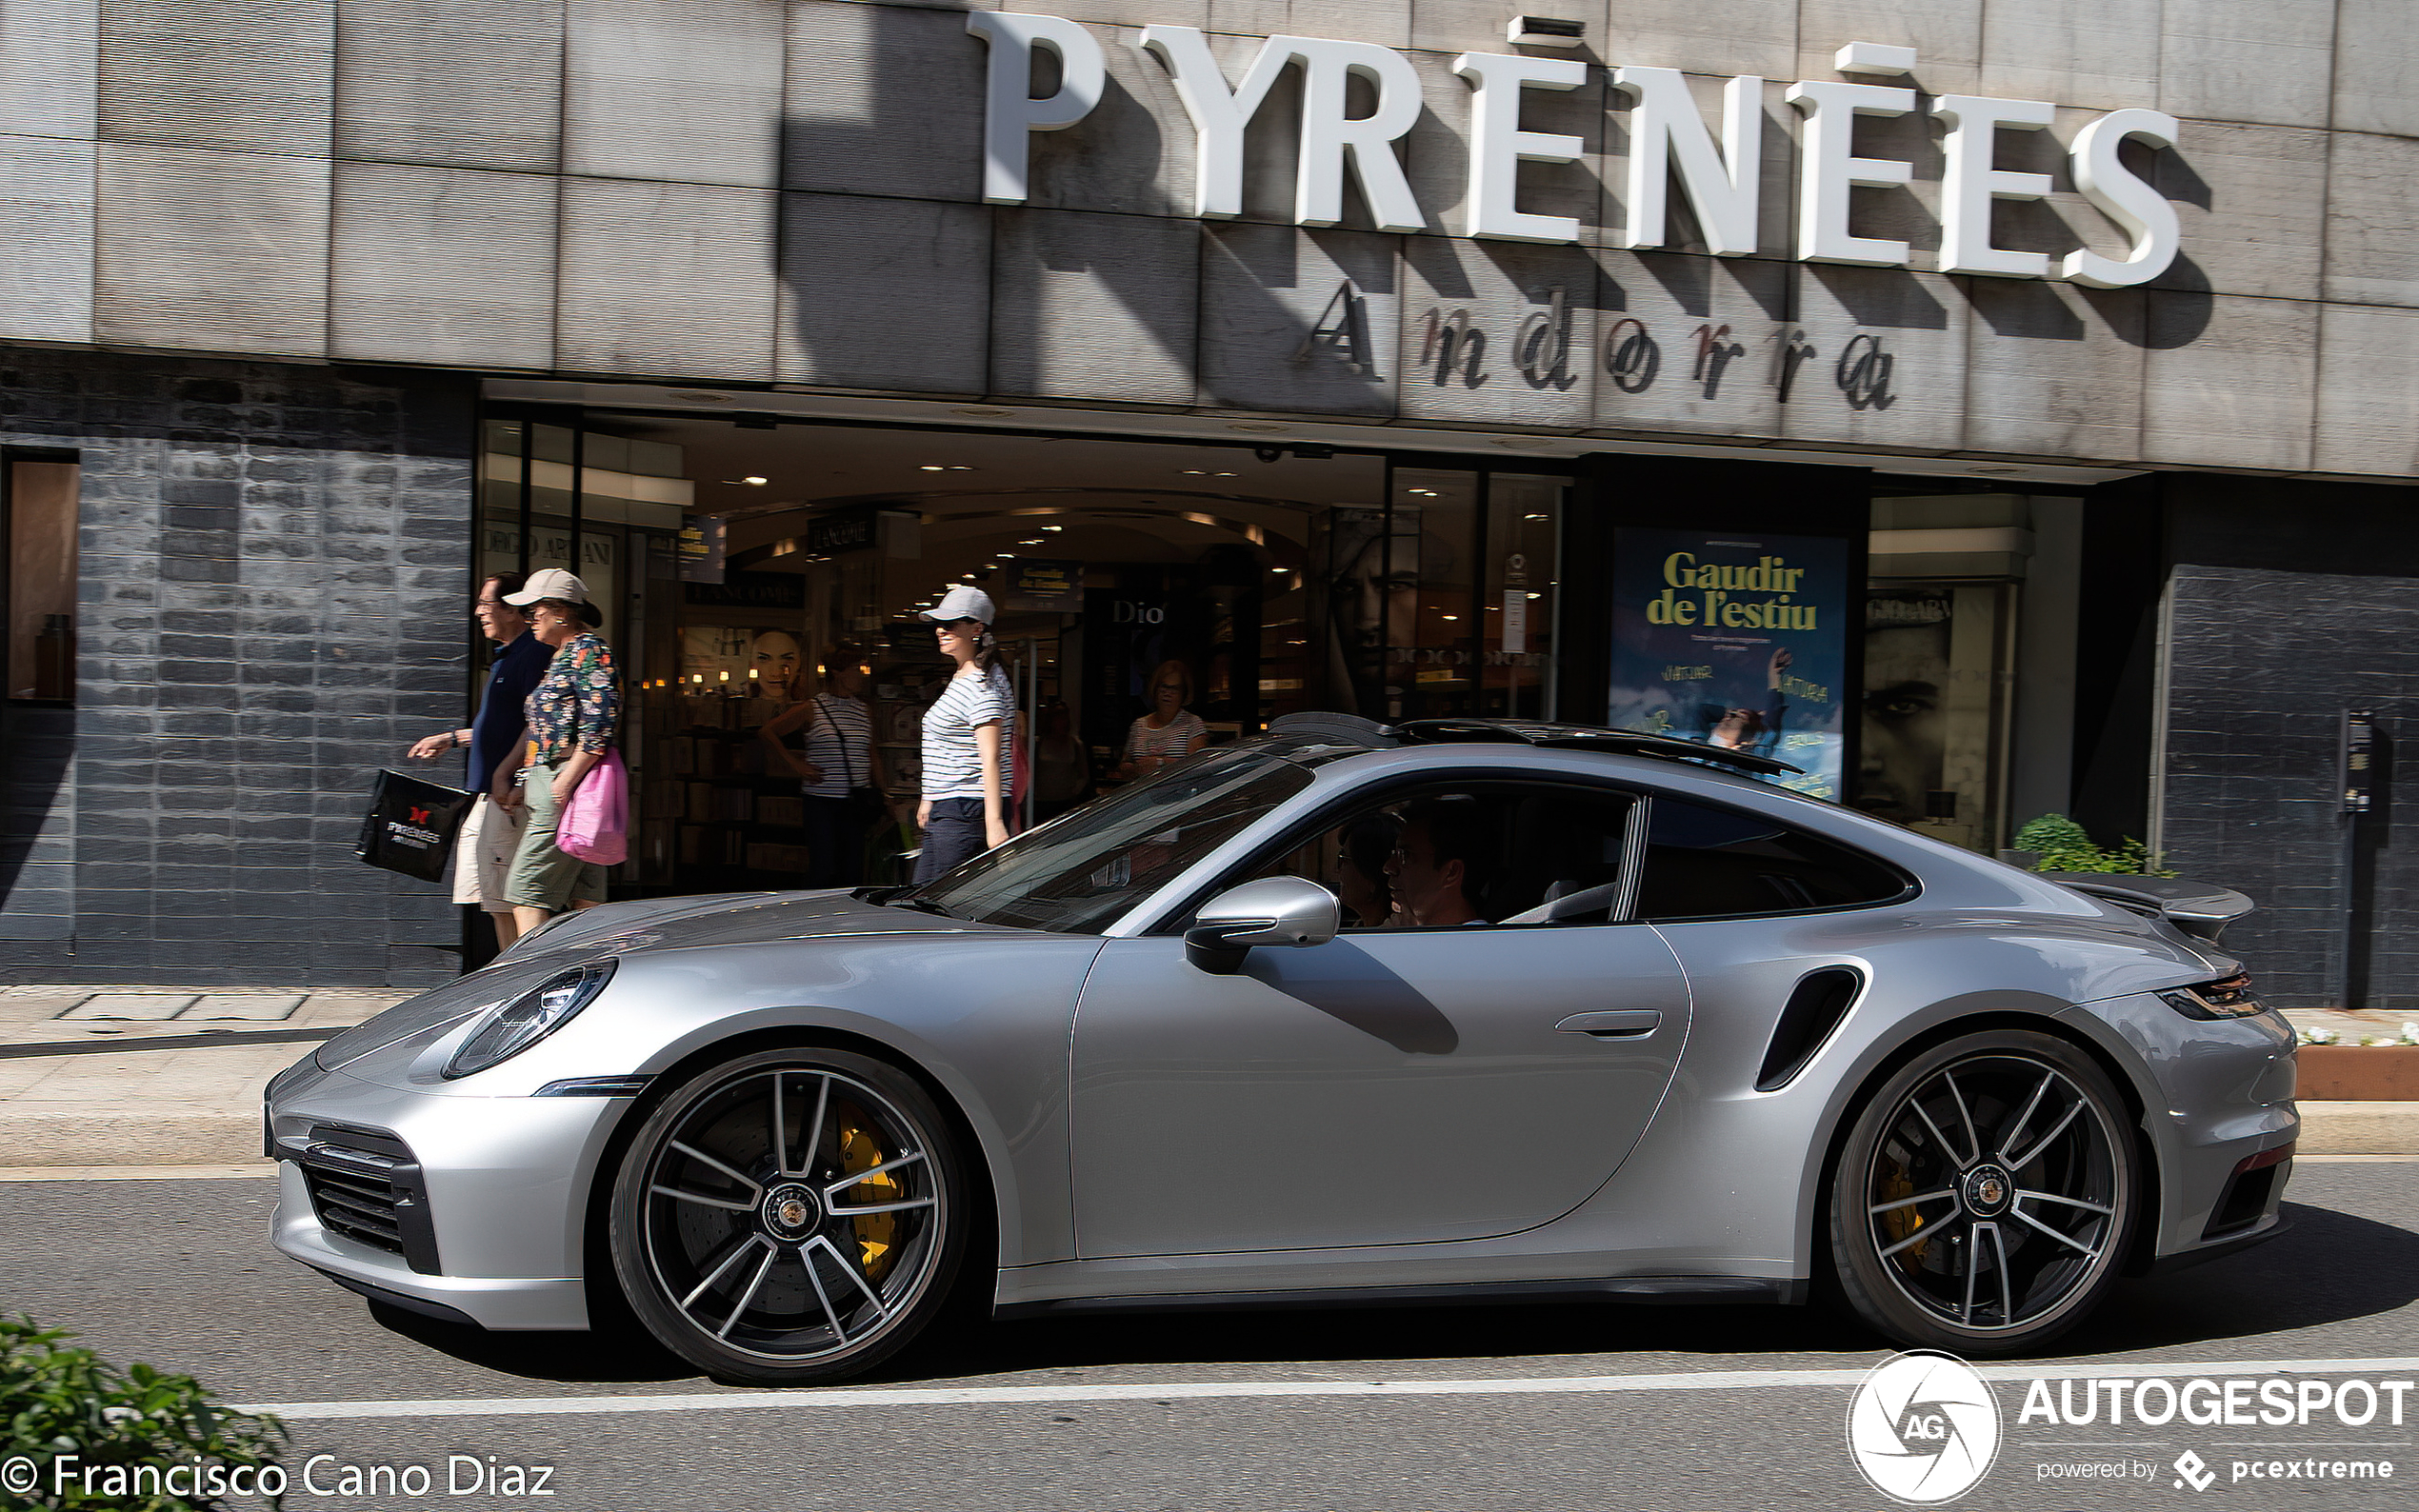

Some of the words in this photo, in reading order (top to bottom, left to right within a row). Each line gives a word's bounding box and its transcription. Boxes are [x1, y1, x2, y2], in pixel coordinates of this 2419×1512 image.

[1297, 279, 1893, 408] Andorra
[1663, 550, 1805, 593] Gaudir
[1646, 588, 1698, 626] de
[1703, 590, 1818, 631] l'estiu
